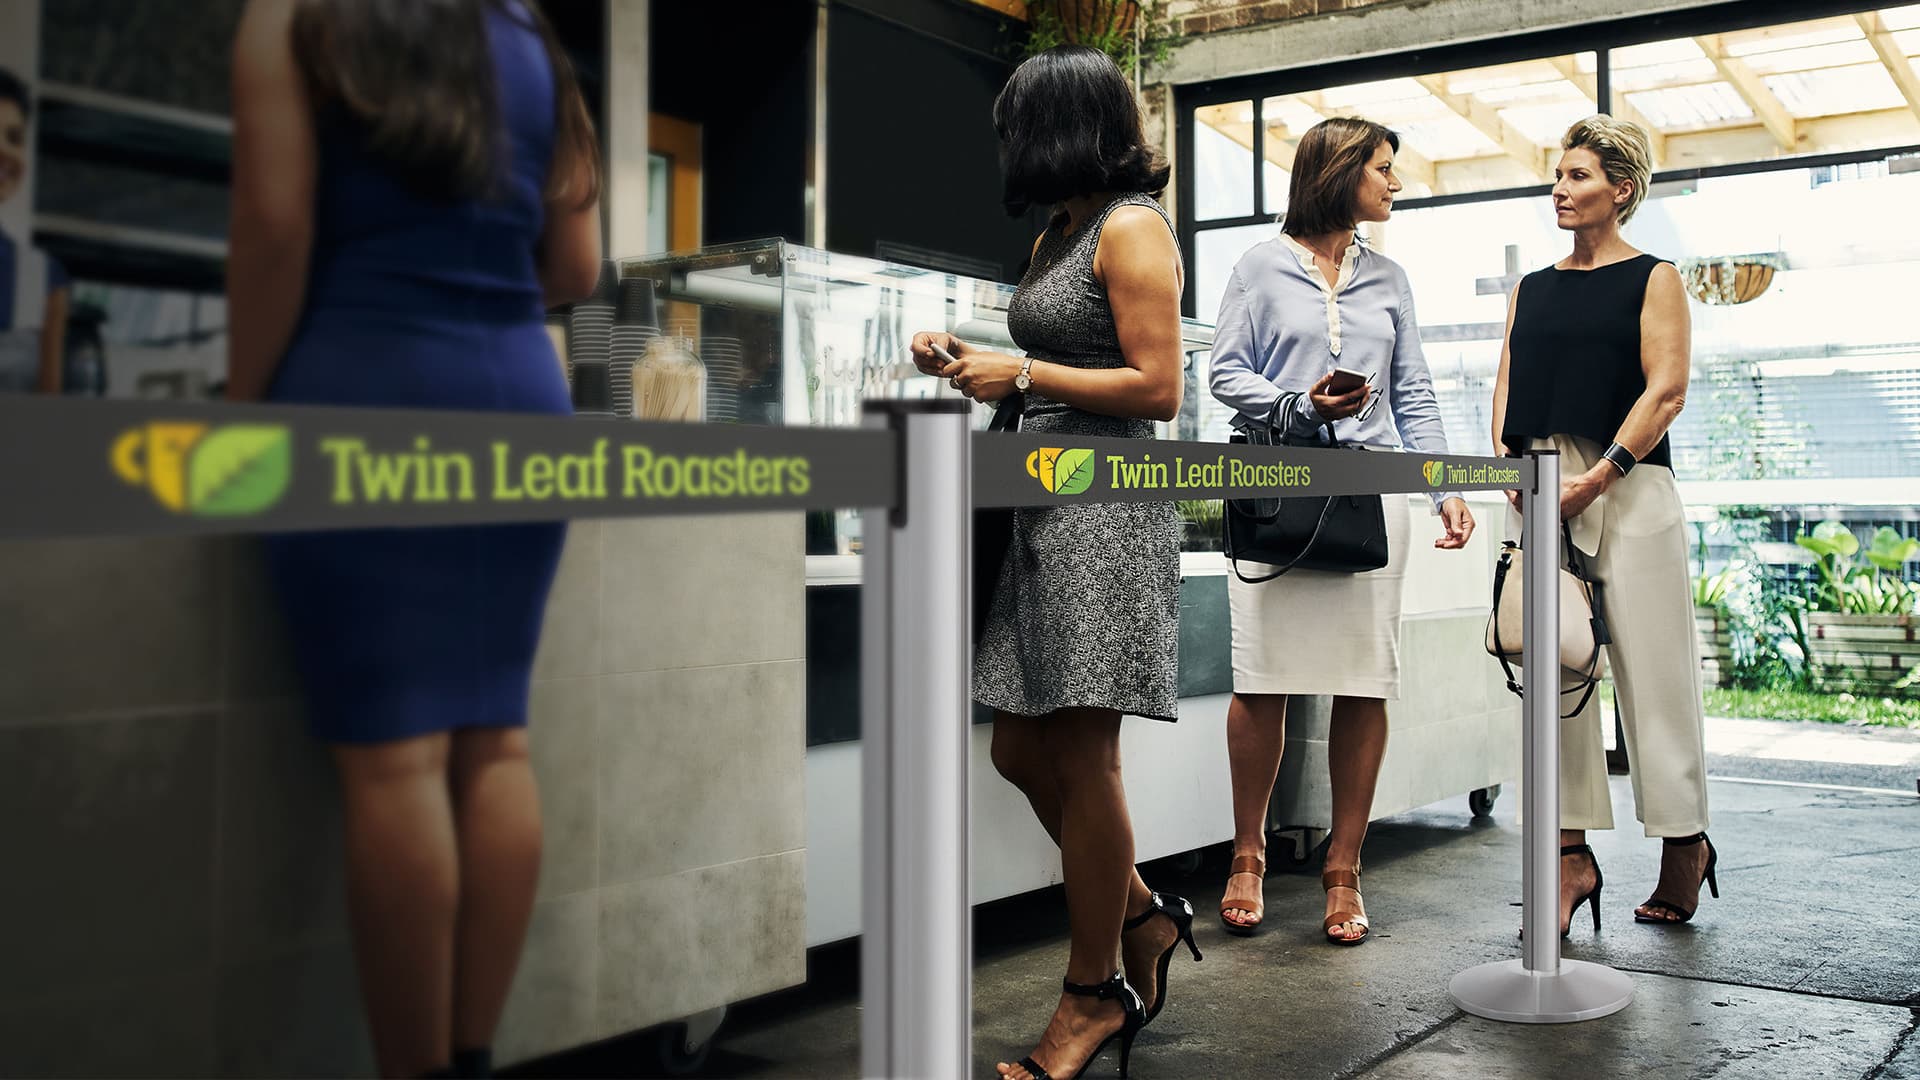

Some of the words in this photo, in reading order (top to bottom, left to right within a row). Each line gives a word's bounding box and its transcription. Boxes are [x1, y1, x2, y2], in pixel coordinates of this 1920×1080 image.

[321, 437, 474, 503] Twin
[493, 439, 609, 501] Leaf
[622, 443, 811, 498] Roasters
[1107, 454, 1169, 489] Twin
[1176, 455, 1225, 488] Leaf
[1230, 459, 1311, 488] Roasters
[1446, 464, 1467, 484] Twin
[1469, 464, 1487, 484] Leaf
[1487, 465, 1520, 484] Roasters
